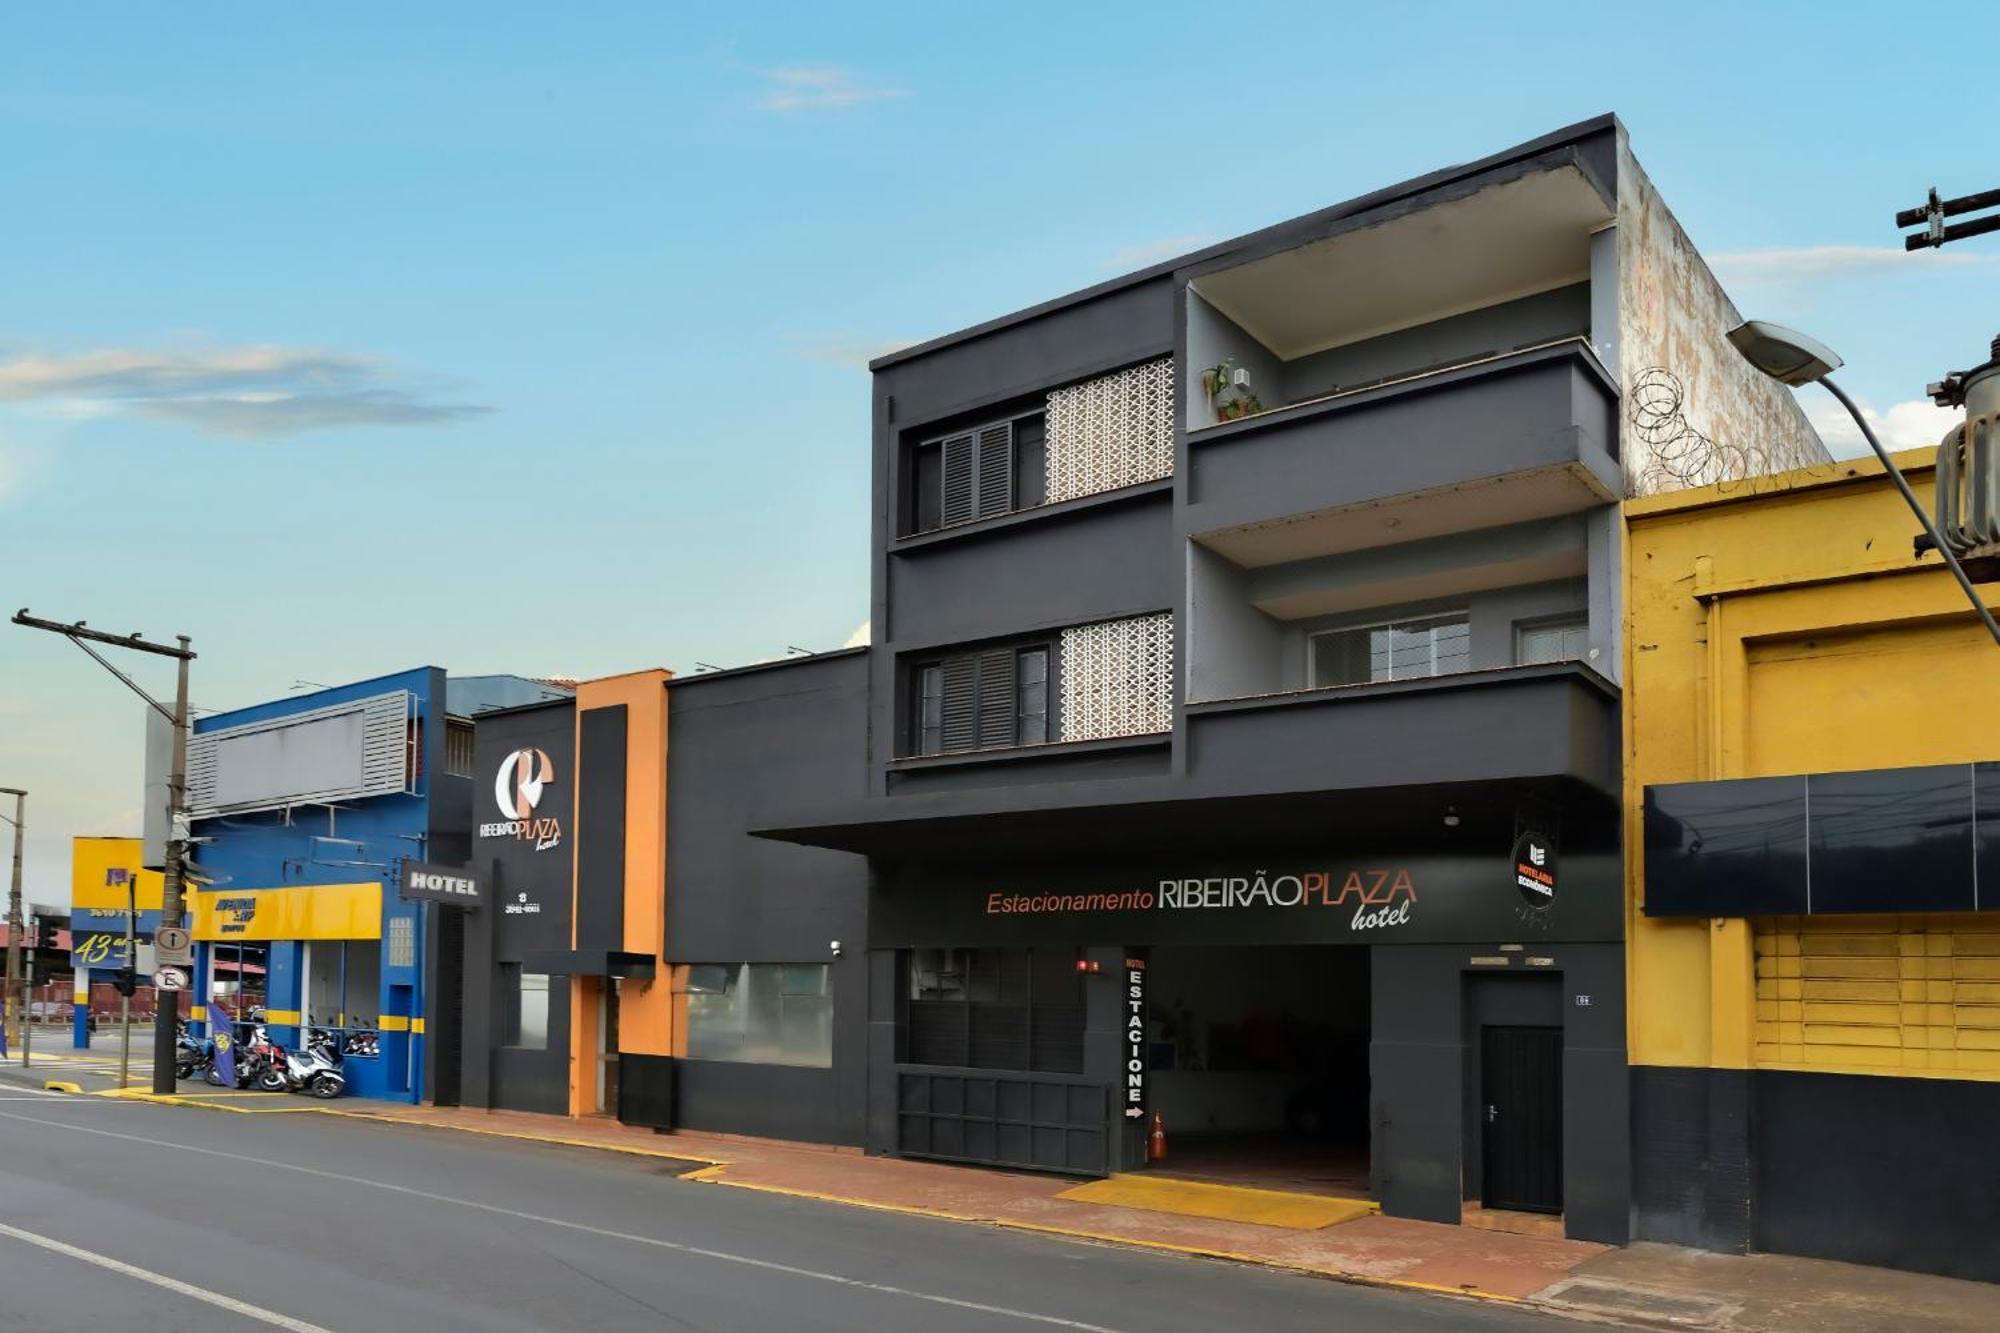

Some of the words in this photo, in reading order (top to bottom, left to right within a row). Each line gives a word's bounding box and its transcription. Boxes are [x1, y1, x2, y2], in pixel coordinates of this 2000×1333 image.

[410, 871, 478, 896] HOTEL
[987, 889, 1153, 913] Estacionamento
[1351, 899, 1410, 930] hotel
[75, 934, 112, 963] 43
[1128, 971, 1142, 1102] ESTACIONE
